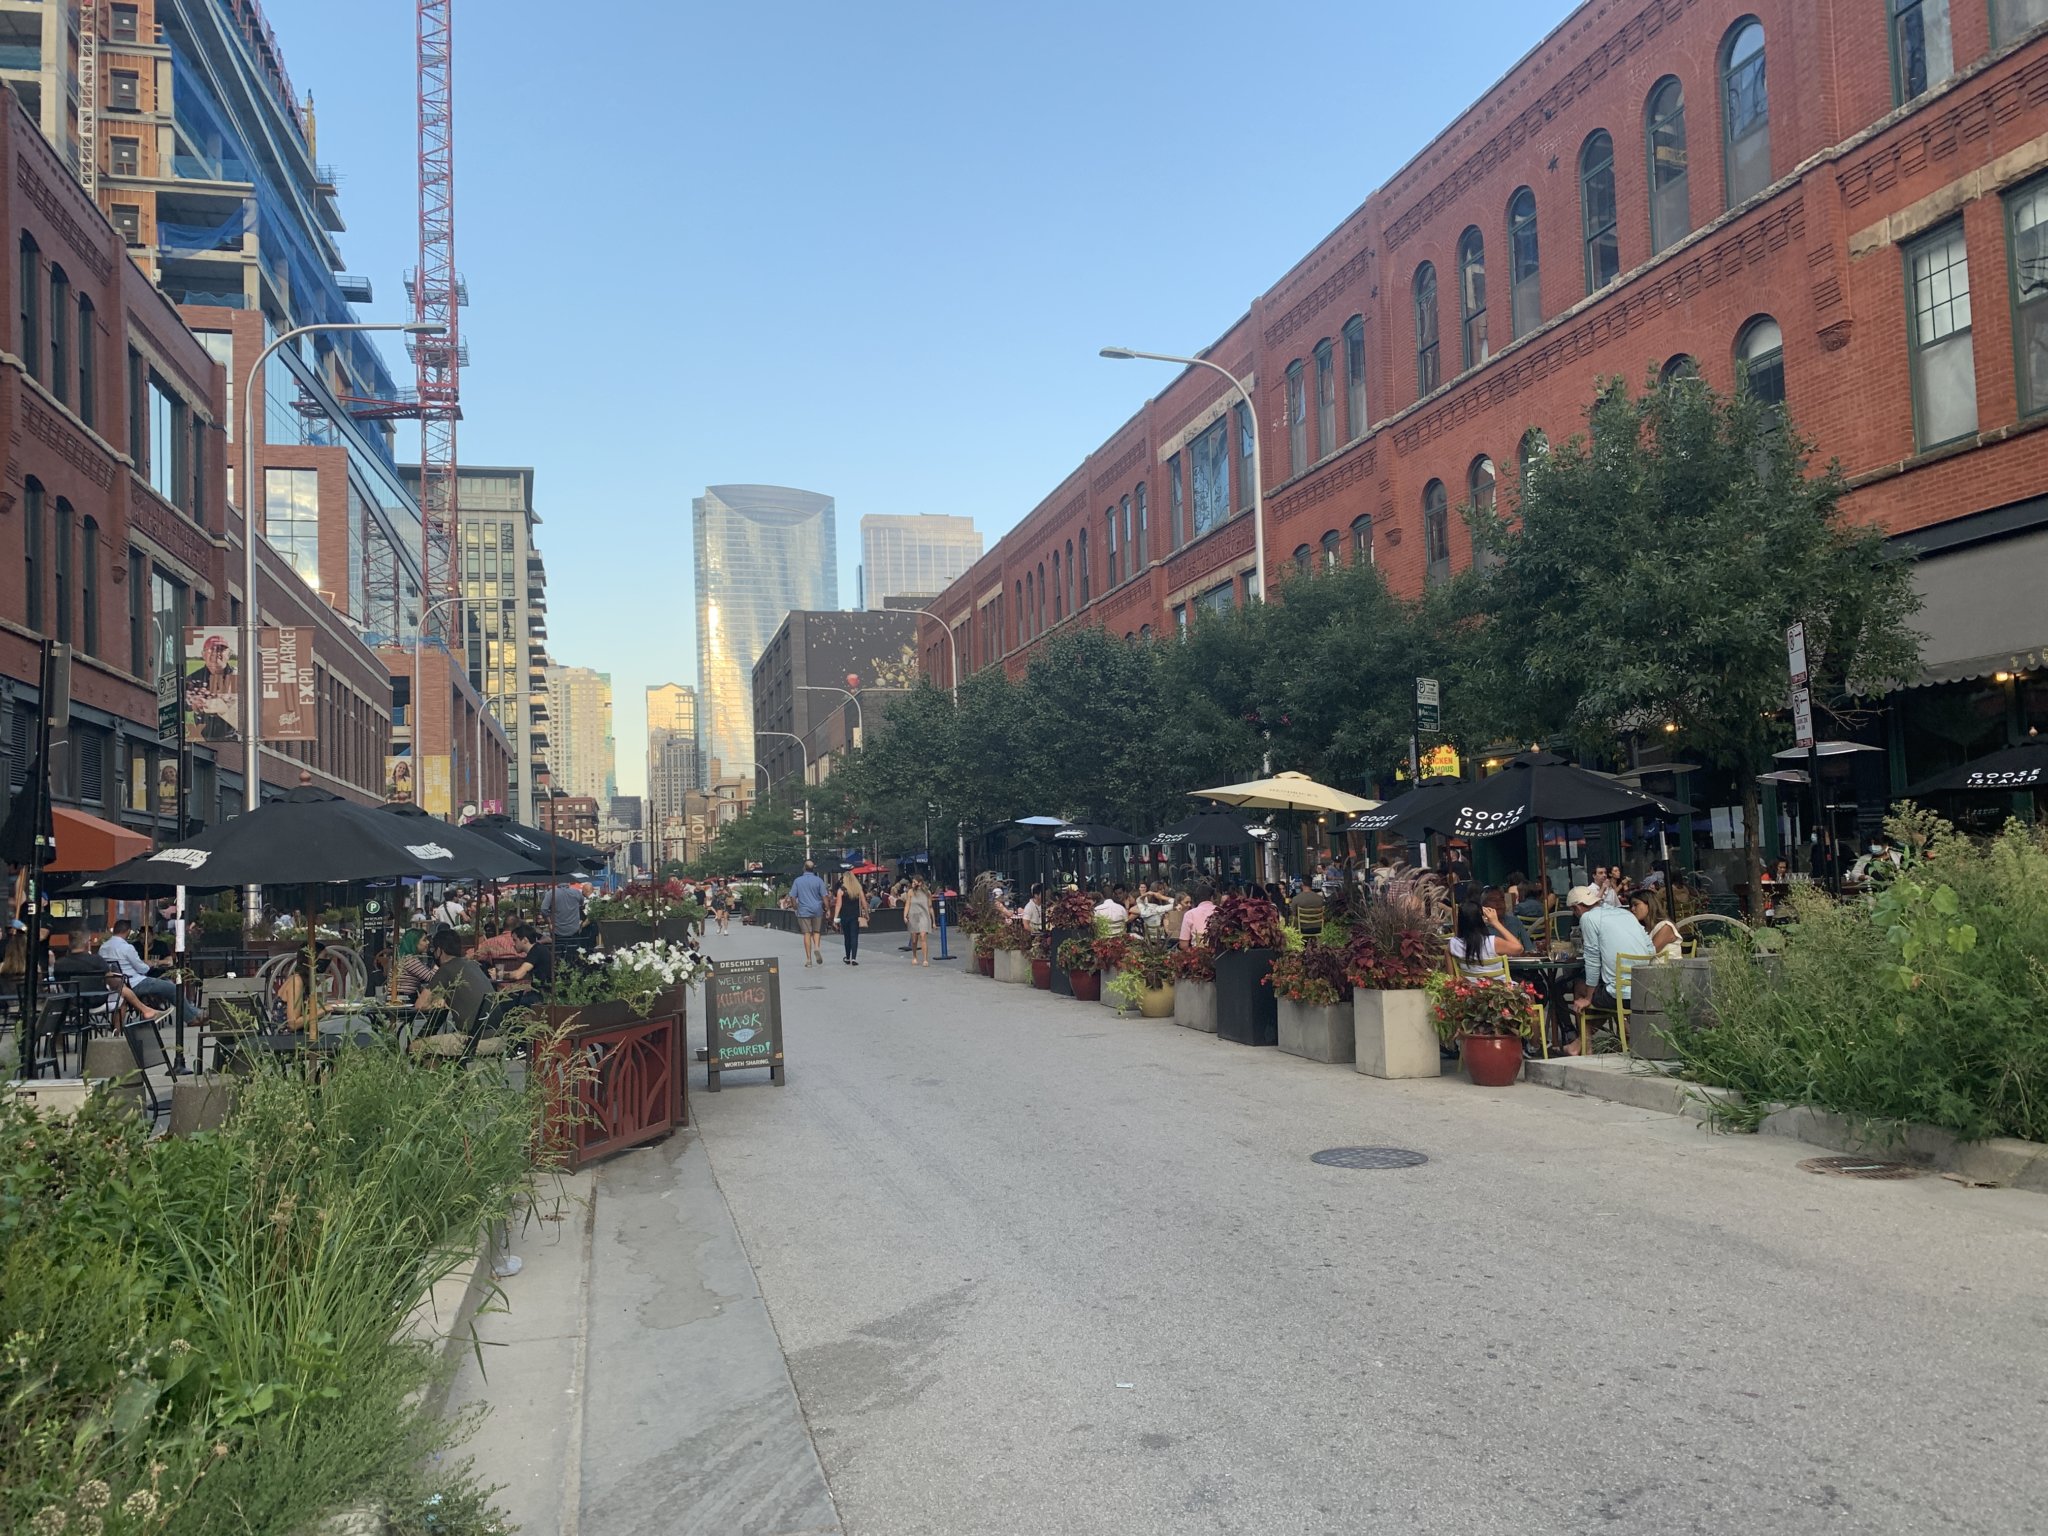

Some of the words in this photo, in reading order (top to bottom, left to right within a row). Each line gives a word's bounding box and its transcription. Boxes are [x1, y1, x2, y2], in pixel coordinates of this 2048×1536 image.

[279, 626, 297, 684] MARKET
[262, 648, 280, 699] FULTON
[298, 668, 315, 705] EXPO
[1971, 768, 2042, 779] GOOSE
[1966, 775, 2038, 785] ISLAND
[1360, 814, 1398, 822] GOOSE
[1460, 804, 1526, 820] GOOSE
[1350, 821, 1388, 829] ISLAND
[1455, 816, 1520, 831] ISLAND
[1454, 829, 1475, 837] BEER
[1477, 825, 1513, 837] COMPANY
[370, 903, 377, 912] P
[720, 959, 765, 968] DESCHUTES
[718, 975, 762, 986] WELCOME
[718, 1013, 761, 1029] MASK
[718, 1041, 771, 1060] REQUIRED!
